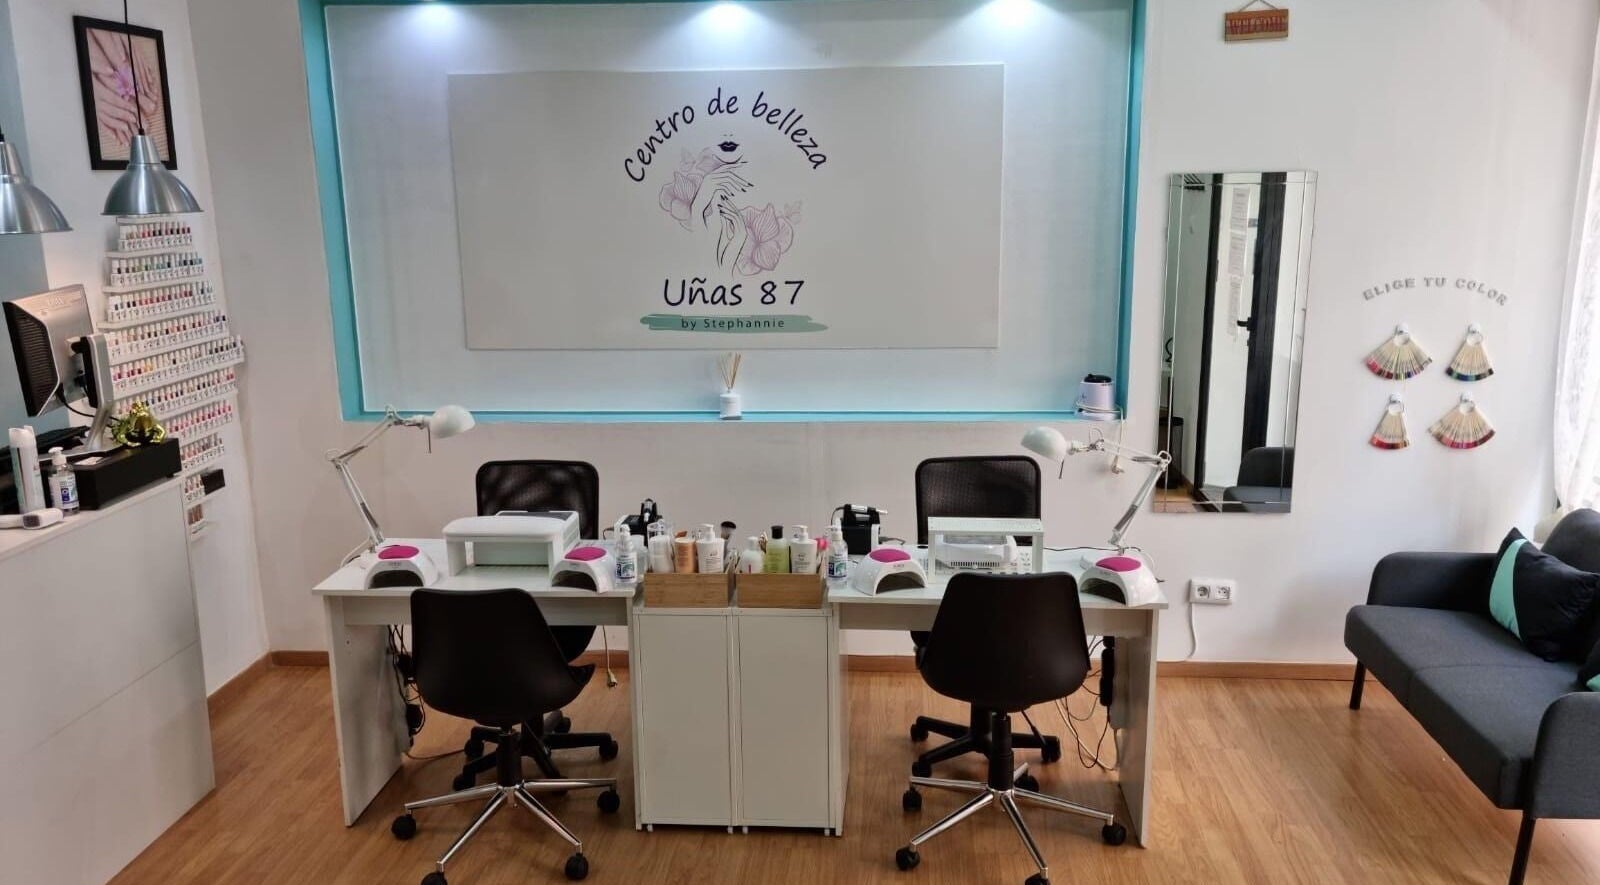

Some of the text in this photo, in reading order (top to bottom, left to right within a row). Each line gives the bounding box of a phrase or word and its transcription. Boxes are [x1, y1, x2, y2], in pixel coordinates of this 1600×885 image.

[624, 87, 827, 183] Centro de belleza
[663, 277, 805, 306] Uñas 87
[1362, 276, 1508, 306] ELIGE TU COLOR
[681, 318, 785, 331] by Stephannie
